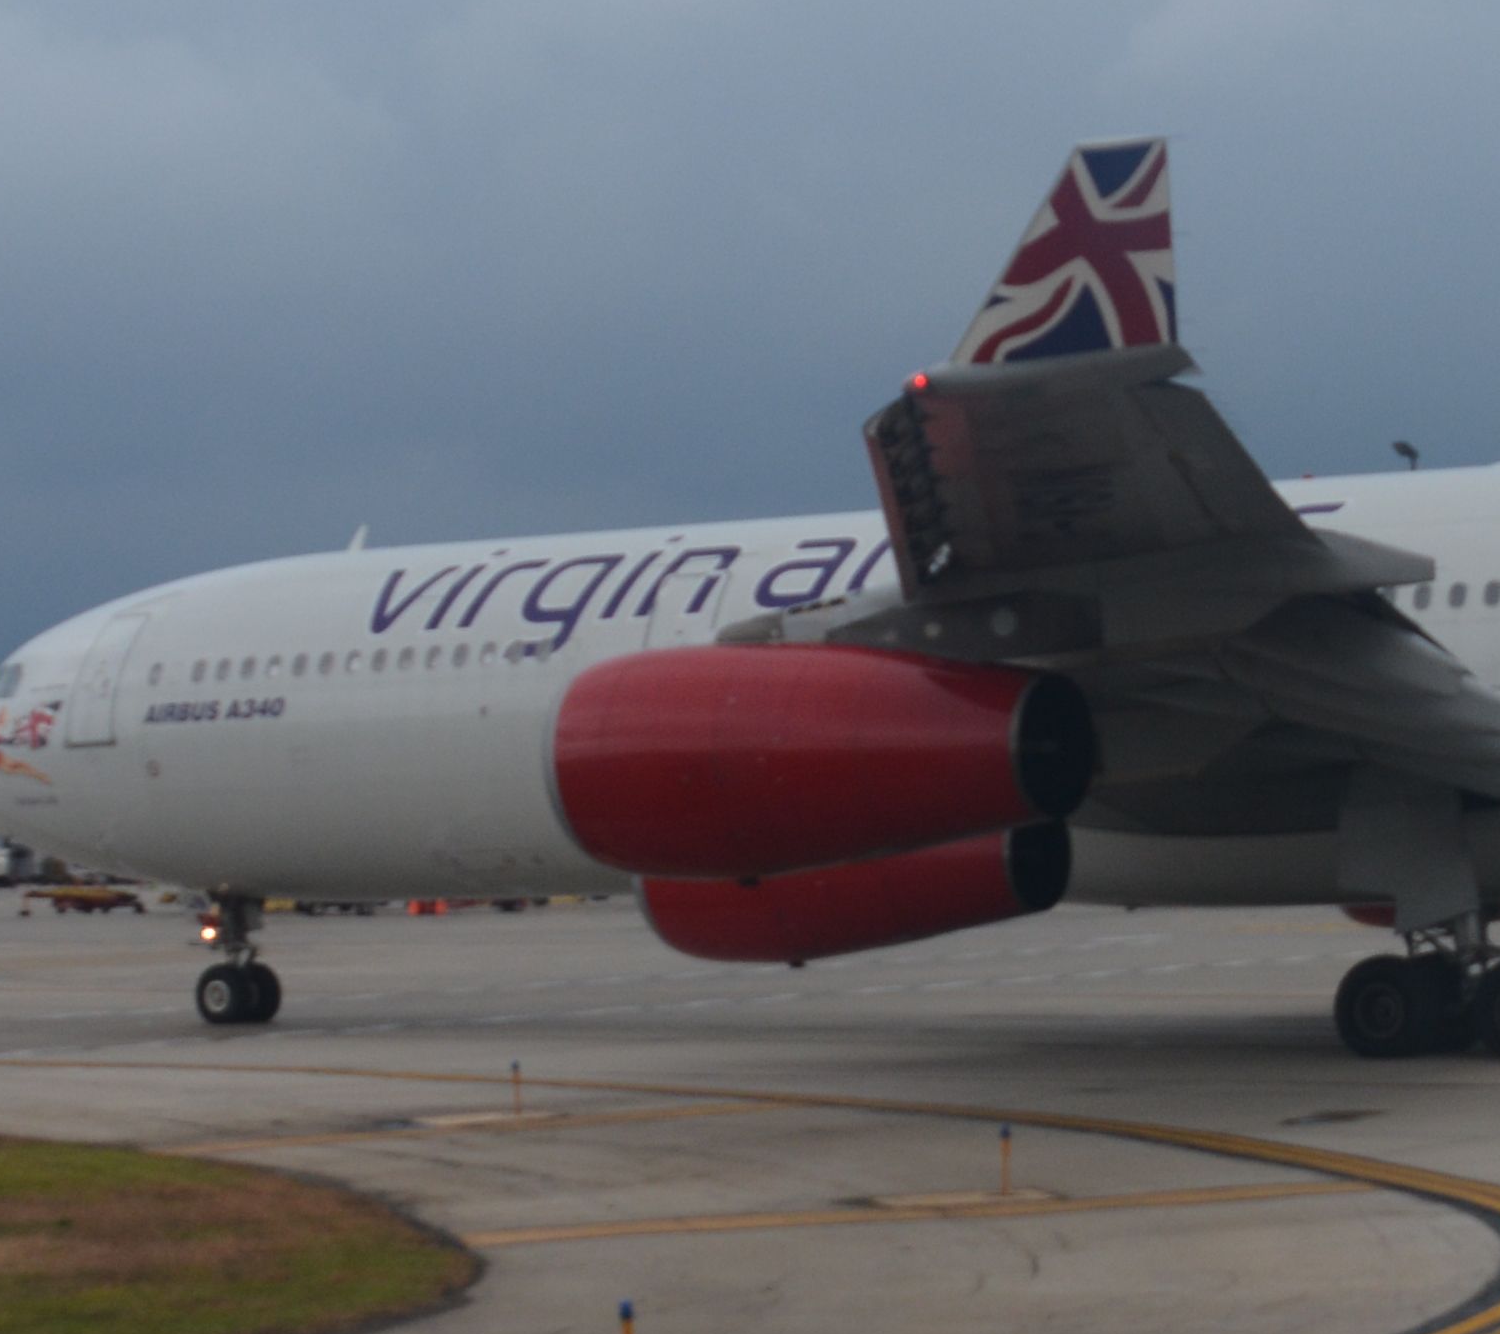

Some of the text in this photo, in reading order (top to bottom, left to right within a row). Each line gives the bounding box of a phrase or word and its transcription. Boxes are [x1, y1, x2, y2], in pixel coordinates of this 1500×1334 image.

[369, 535, 741, 657] virgin
[144, 696, 286, 723] AIRBUS A340
